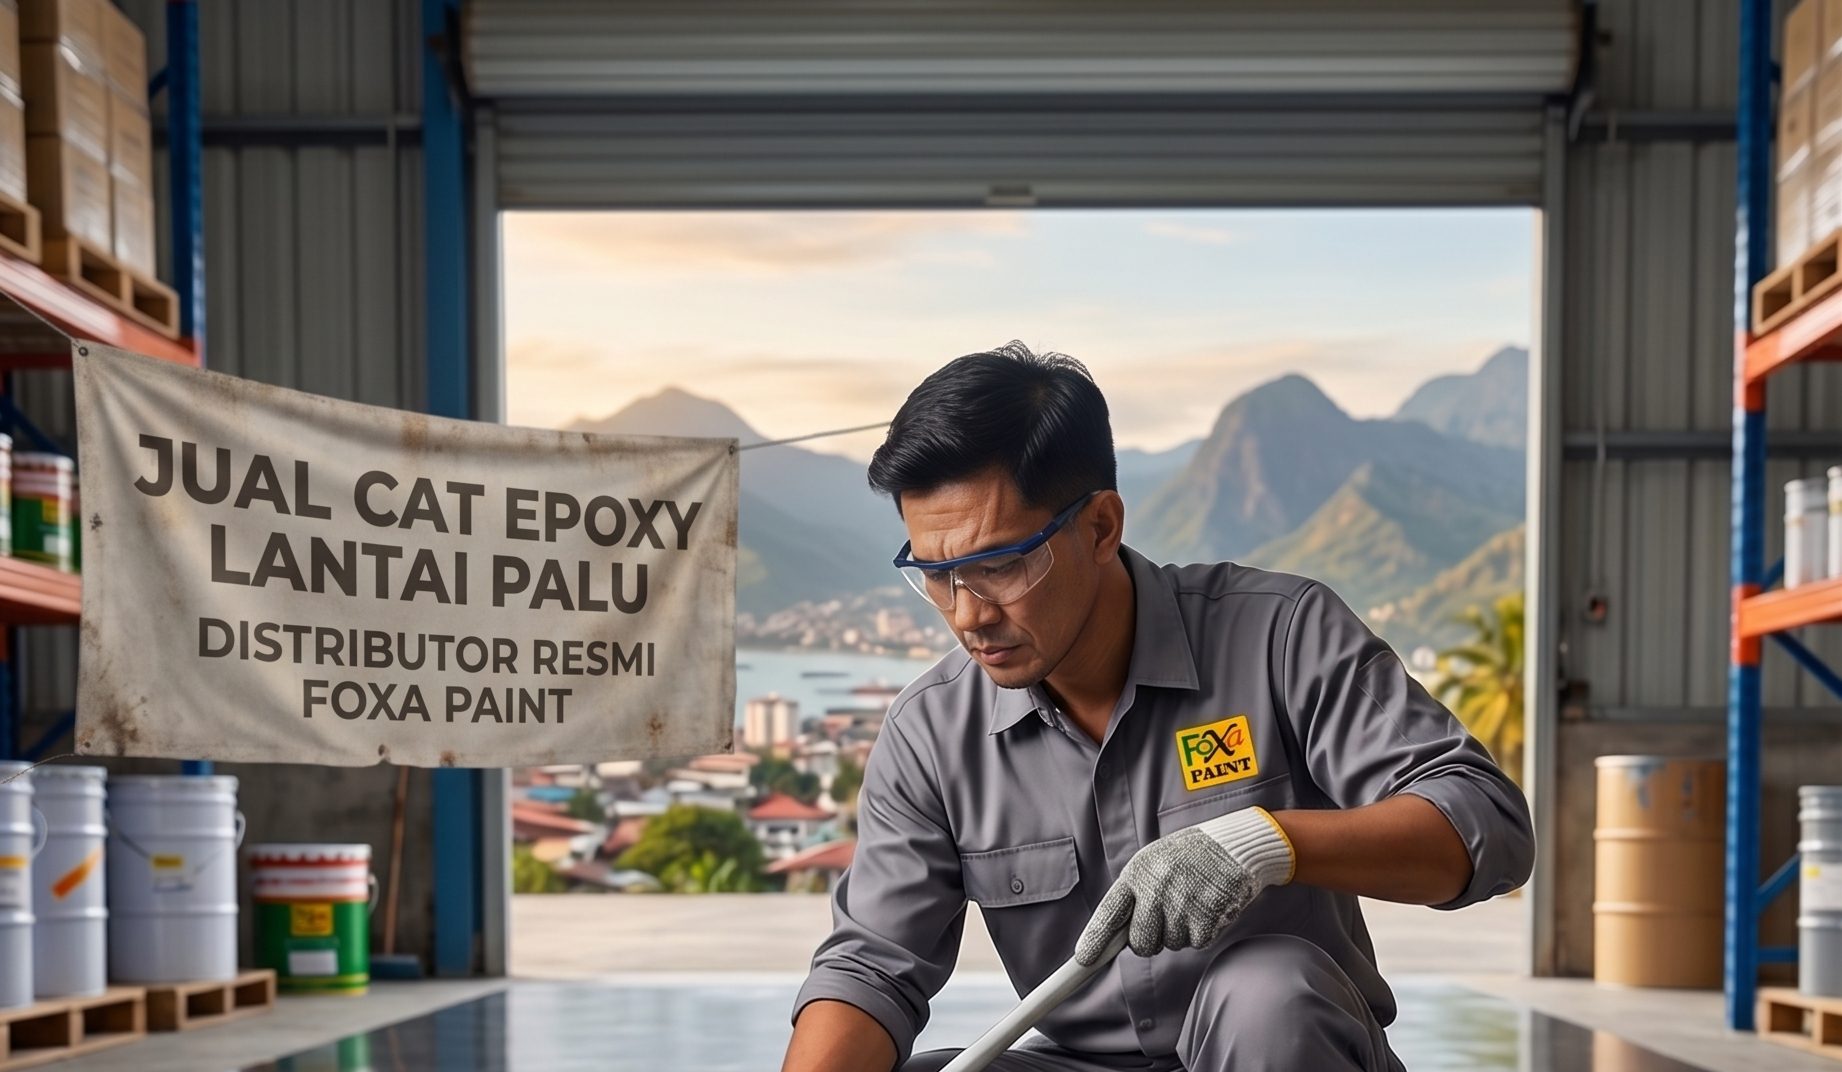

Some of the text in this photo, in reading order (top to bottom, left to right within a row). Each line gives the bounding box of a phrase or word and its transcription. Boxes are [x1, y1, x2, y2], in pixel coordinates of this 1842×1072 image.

[134, 433, 703, 551] JUAL CAT EPOXY
[210, 523, 649, 615] LANTAI PALU
[198, 616, 656, 677] DISTRIBUTOR RESMI
[303, 678, 573, 724] FOXA PAINT
[1190, 757, 1251, 784] PAINT
